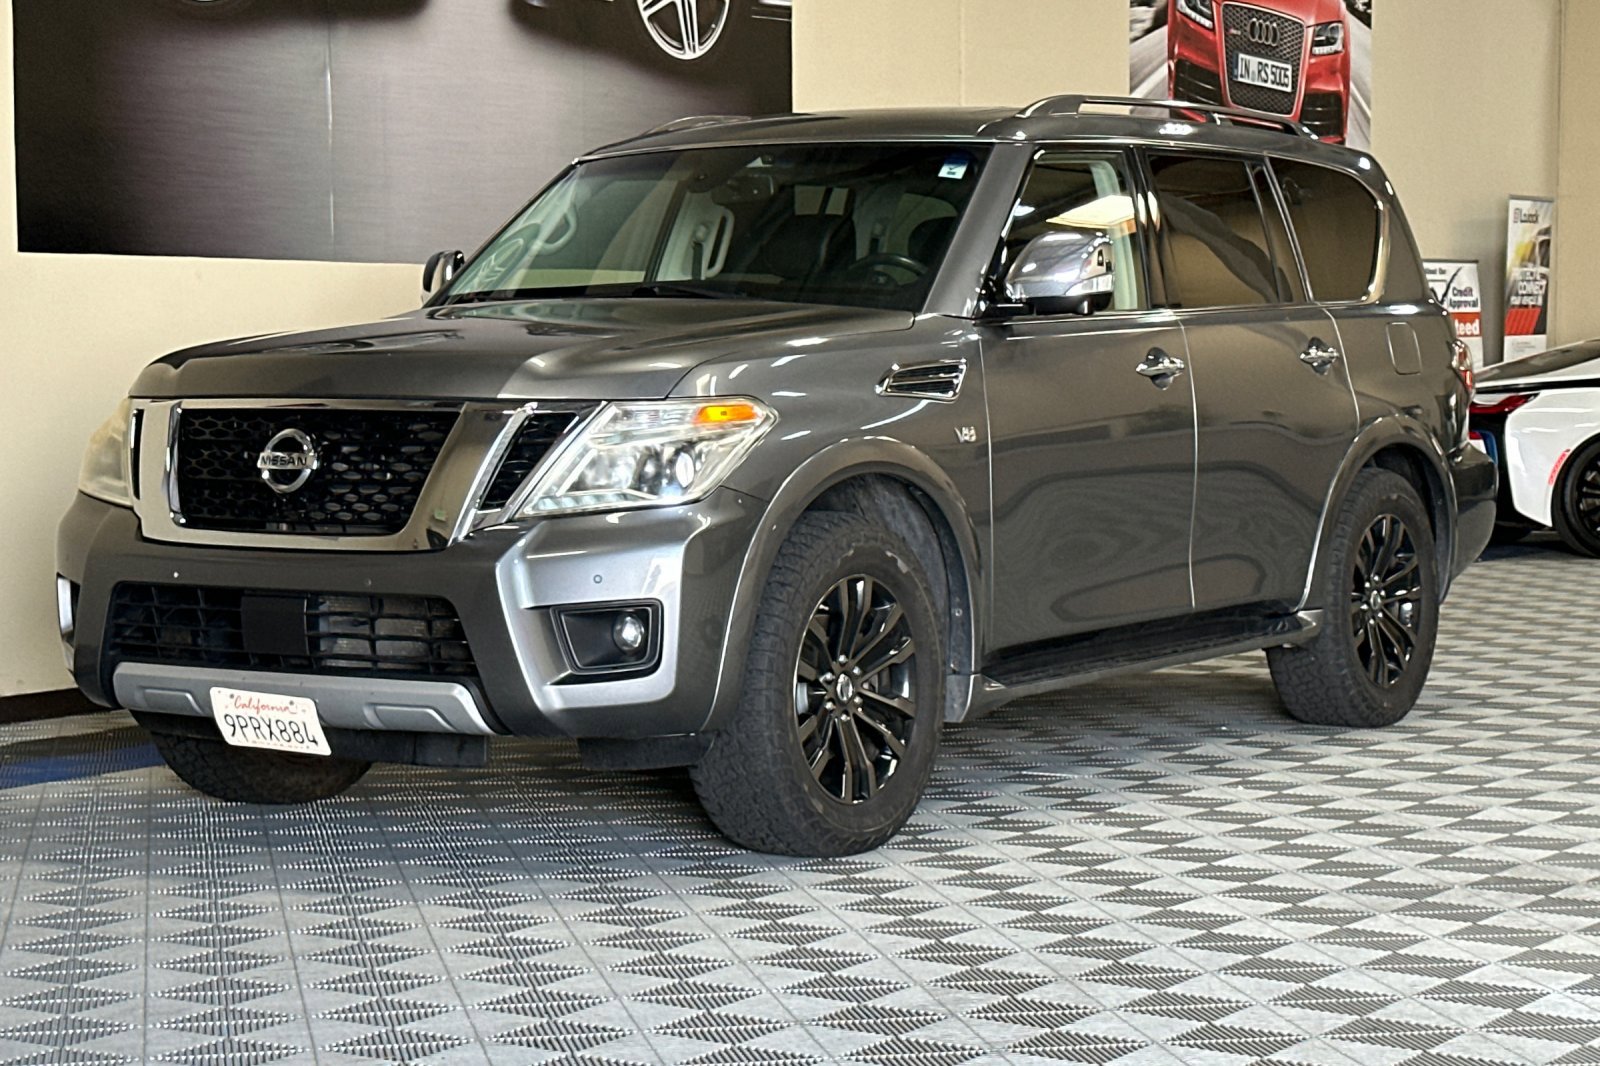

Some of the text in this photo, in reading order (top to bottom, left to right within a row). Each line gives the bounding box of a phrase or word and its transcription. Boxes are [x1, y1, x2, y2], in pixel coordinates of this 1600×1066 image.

[1240, 57, 1250, 80] IN
[1257, 61, 1269, 83] RS
[1452, 287, 1473, 297] Credit
[260, 456, 307, 466] NISSAN
[234, 695, 298, 715] California
[223, 713, 319, 746] 9PRX884
